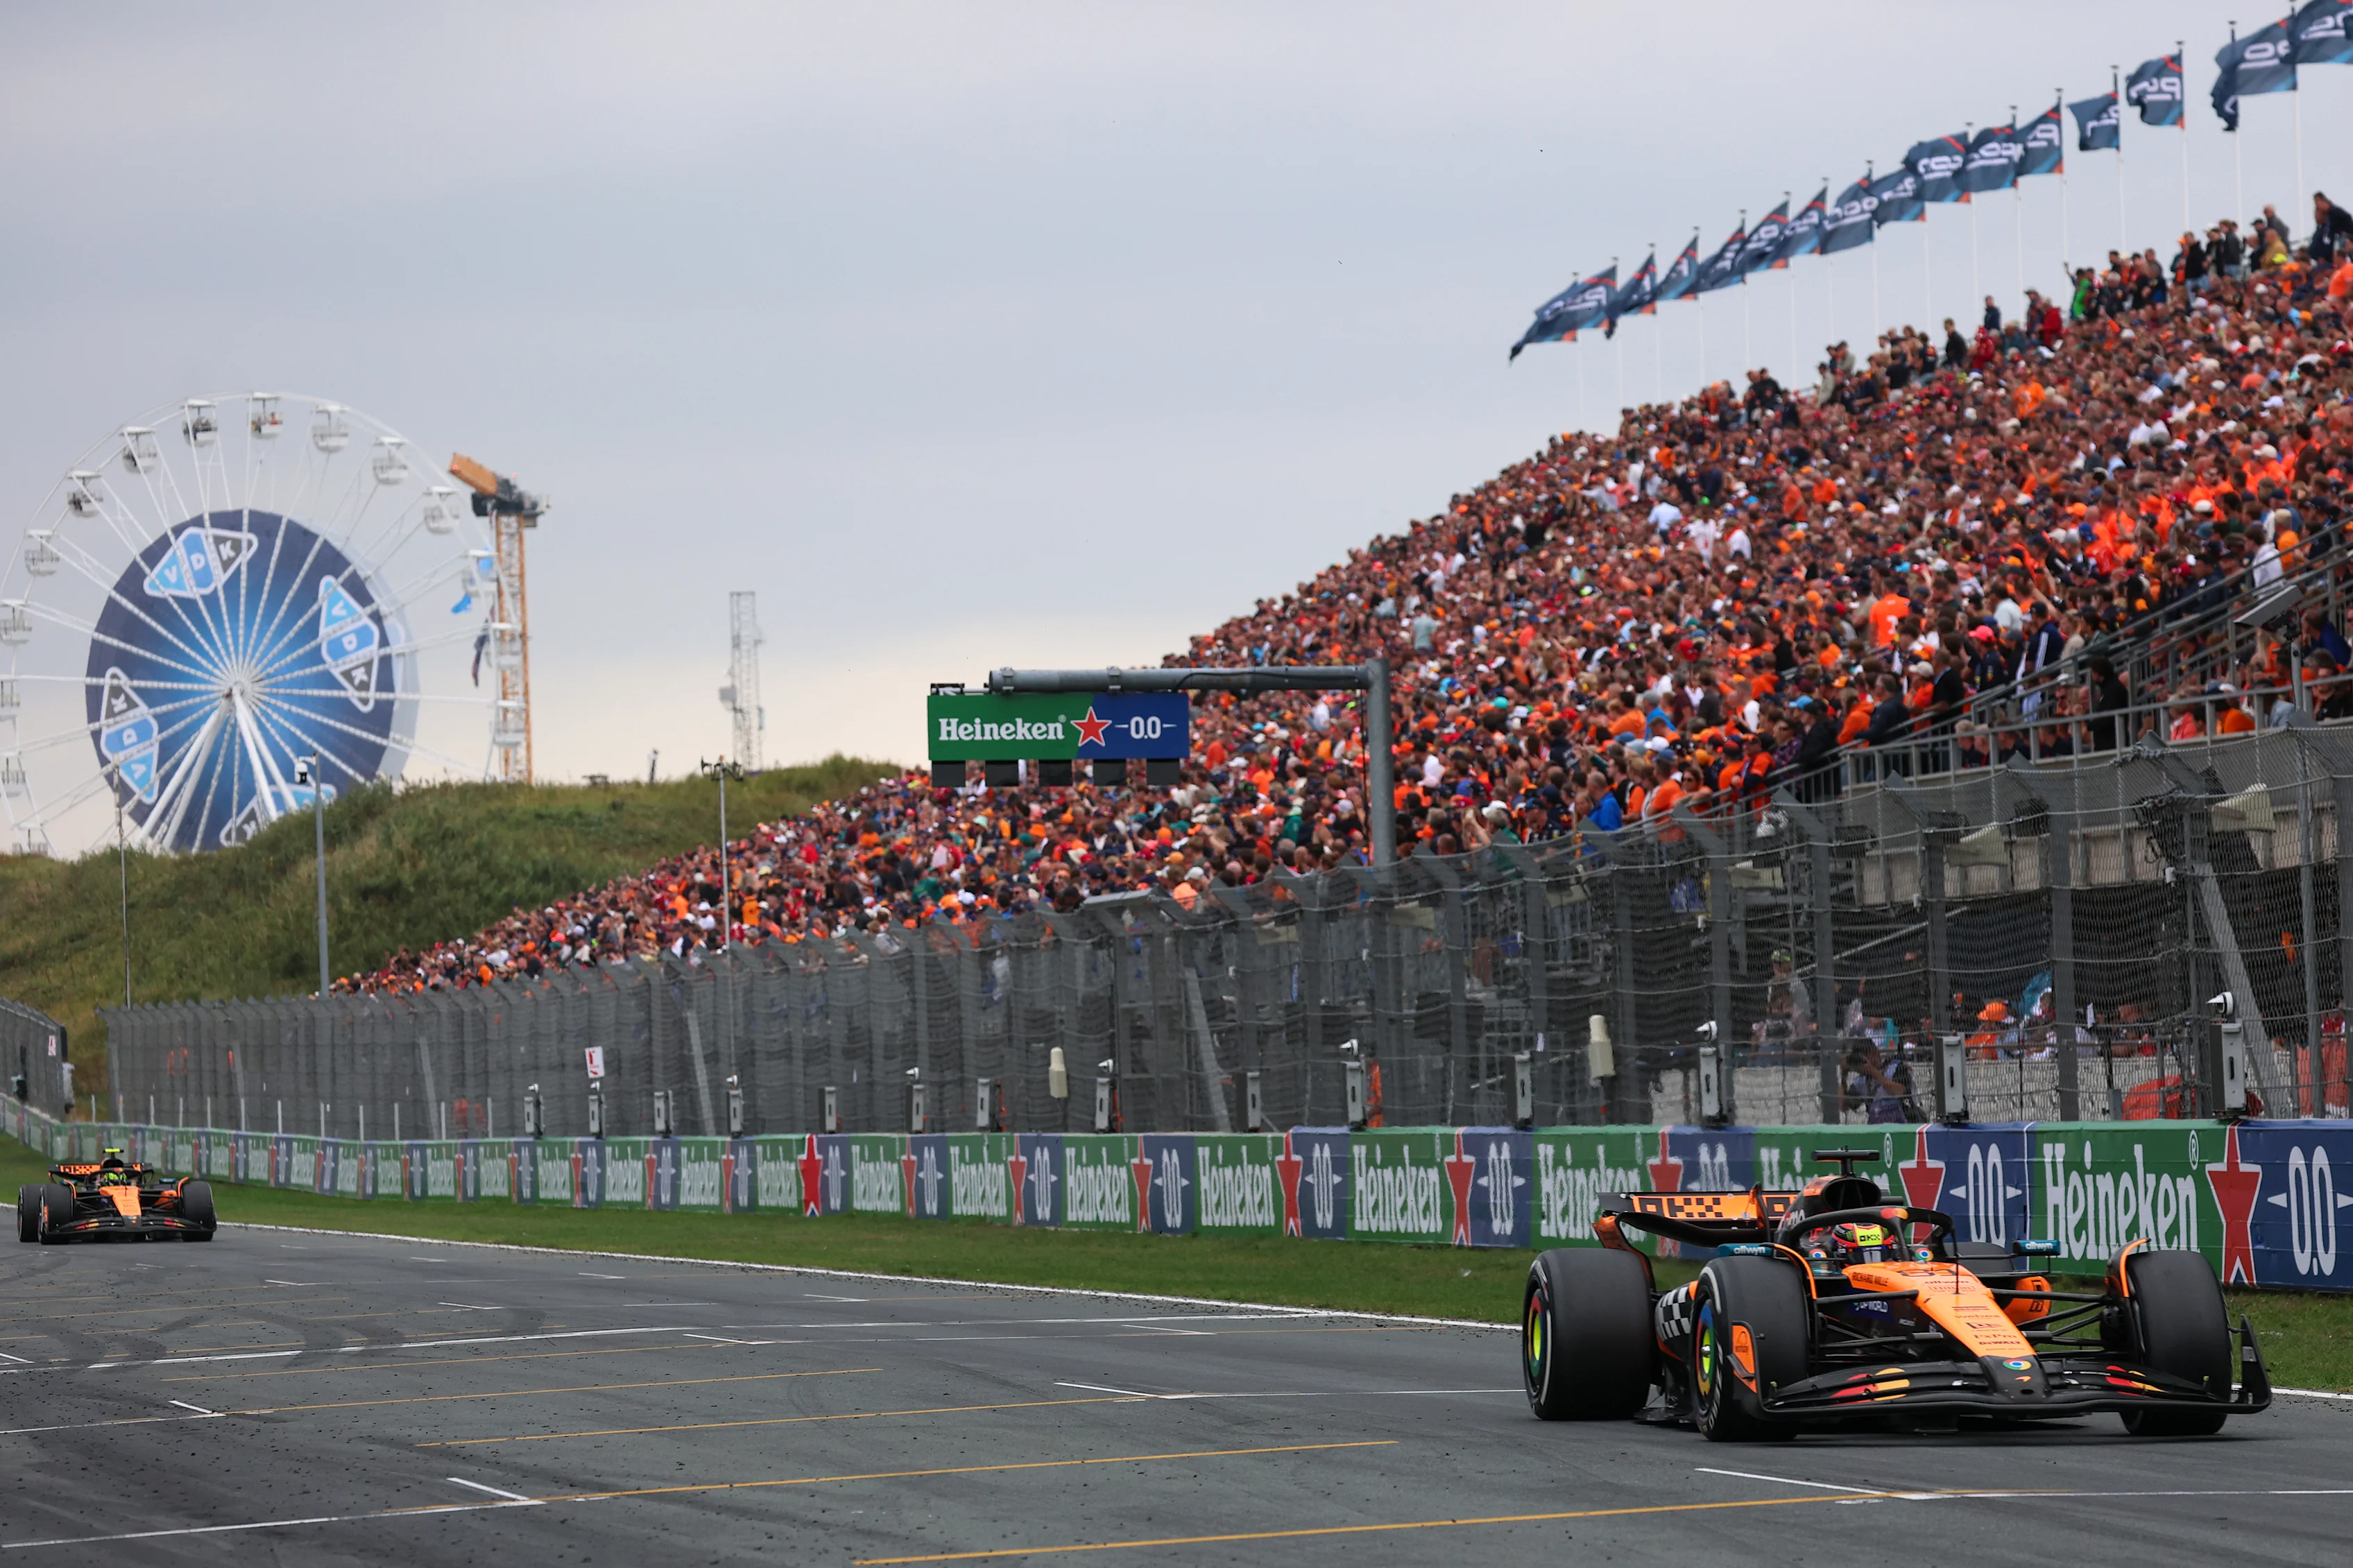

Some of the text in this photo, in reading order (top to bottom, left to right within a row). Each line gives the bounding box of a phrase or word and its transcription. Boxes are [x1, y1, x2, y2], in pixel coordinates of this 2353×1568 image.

[939, 718, 1065, 741] Heineken
[949, 1144, 1007, 1216] Heineken
[1065, 1146, 1131, 1223] Heineken
[1197, 1144, 1275, 1227] Heineken
[1353, 1144, 1442, 1234] Heineken
[2043, 1140, 2336, 1276] Heineken 0.0
[1734, 1245, 1766, 1255] allwyn
[1852, 1272, 1889, 1286] RICHARD MILLE
